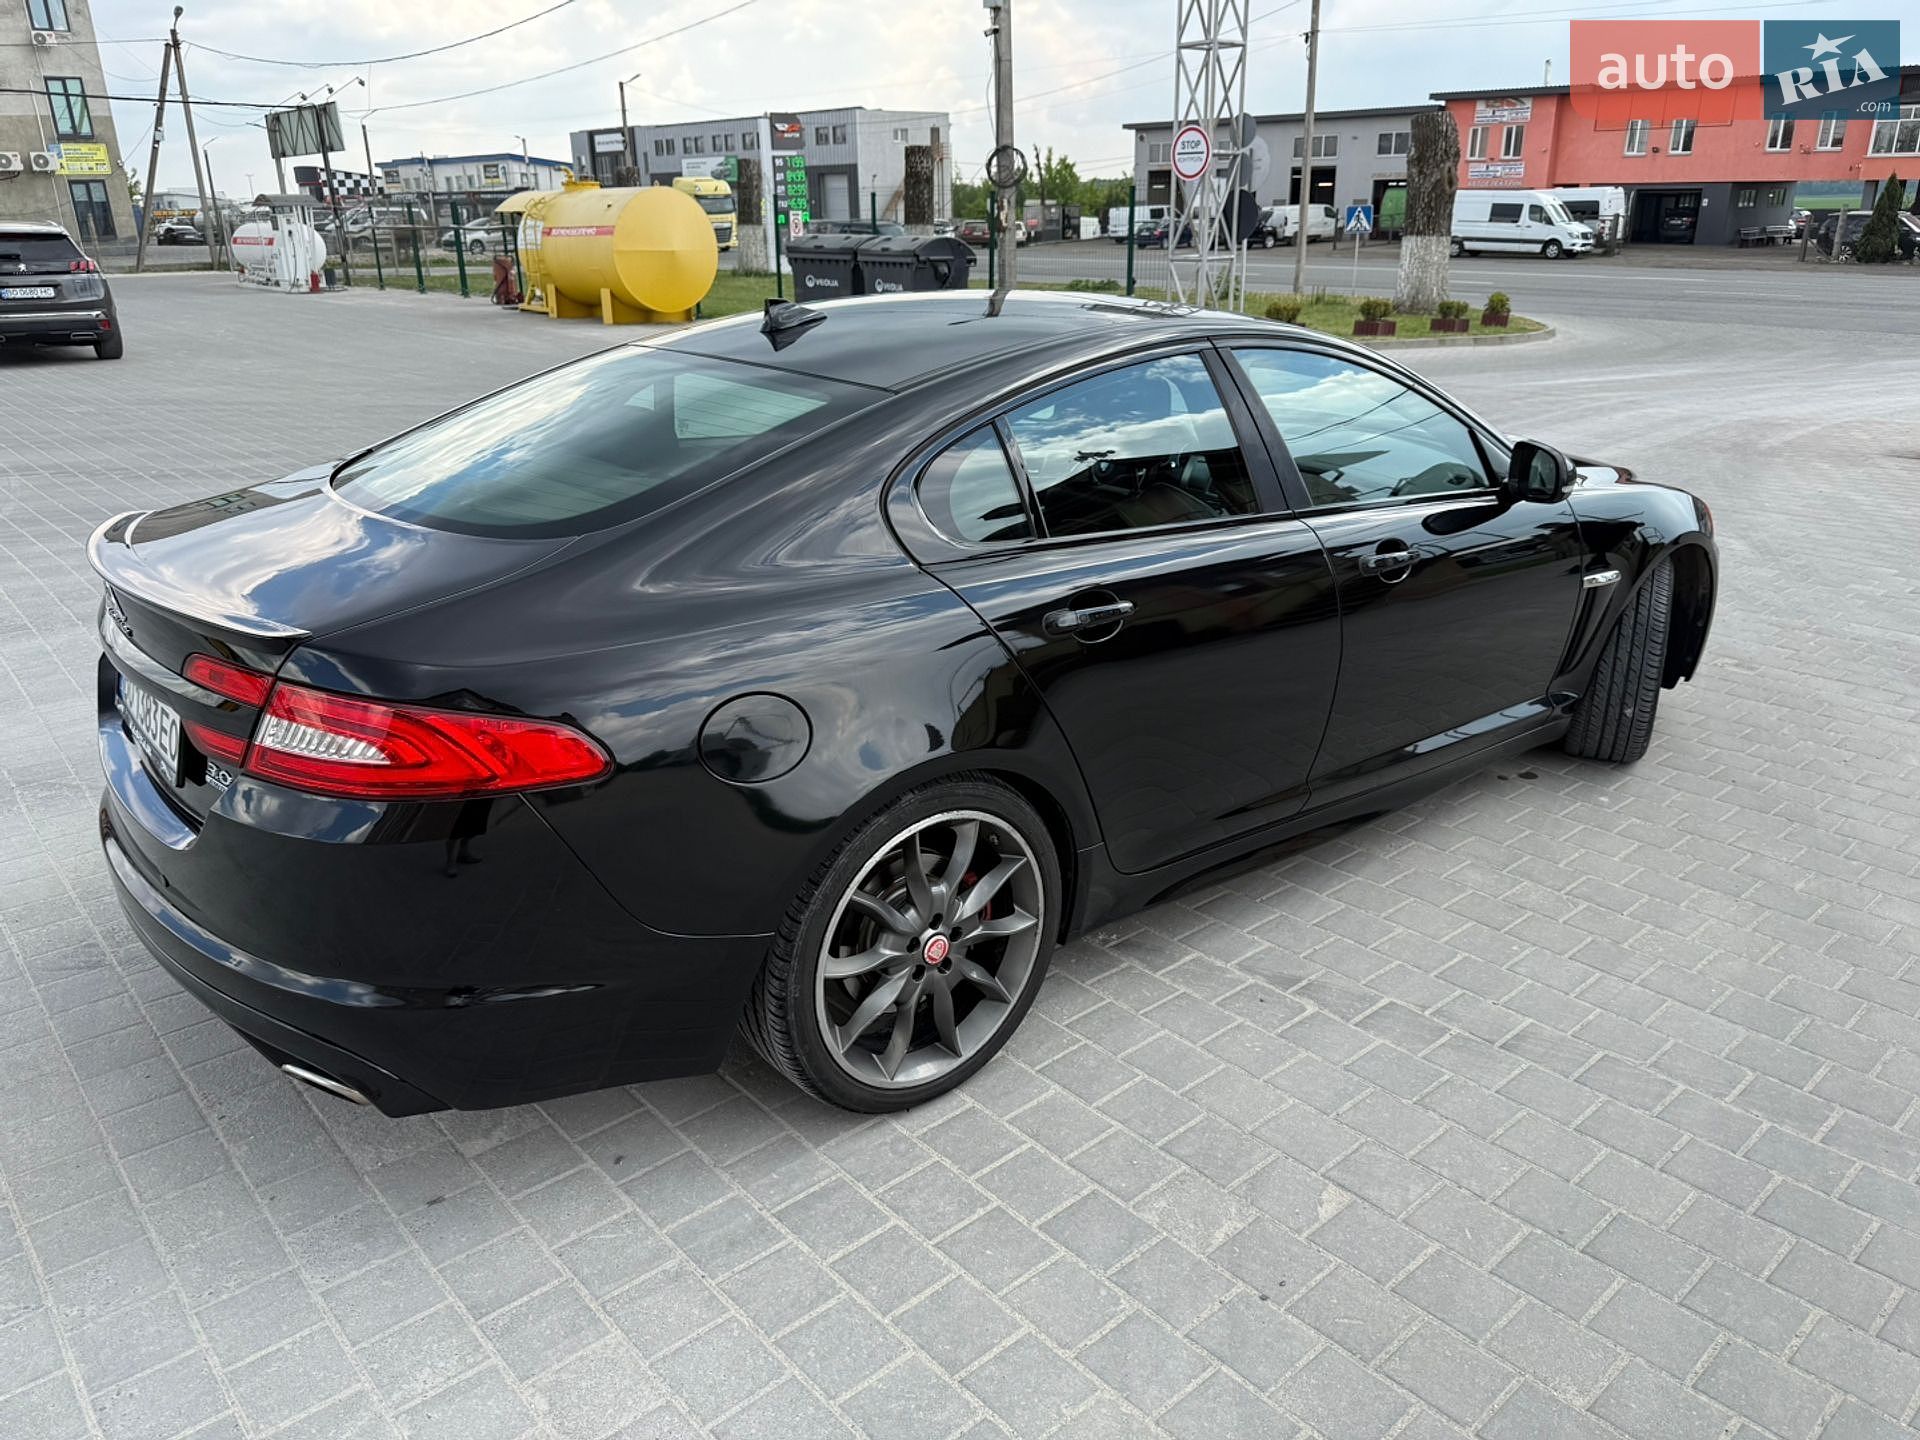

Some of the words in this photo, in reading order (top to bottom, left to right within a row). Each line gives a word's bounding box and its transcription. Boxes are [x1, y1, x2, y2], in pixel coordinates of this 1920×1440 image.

[1181, 140, 1201, 150] STOP
[815, 278, 839, 287] VEOLIA
[206, 761, 233, 786] 3.0
